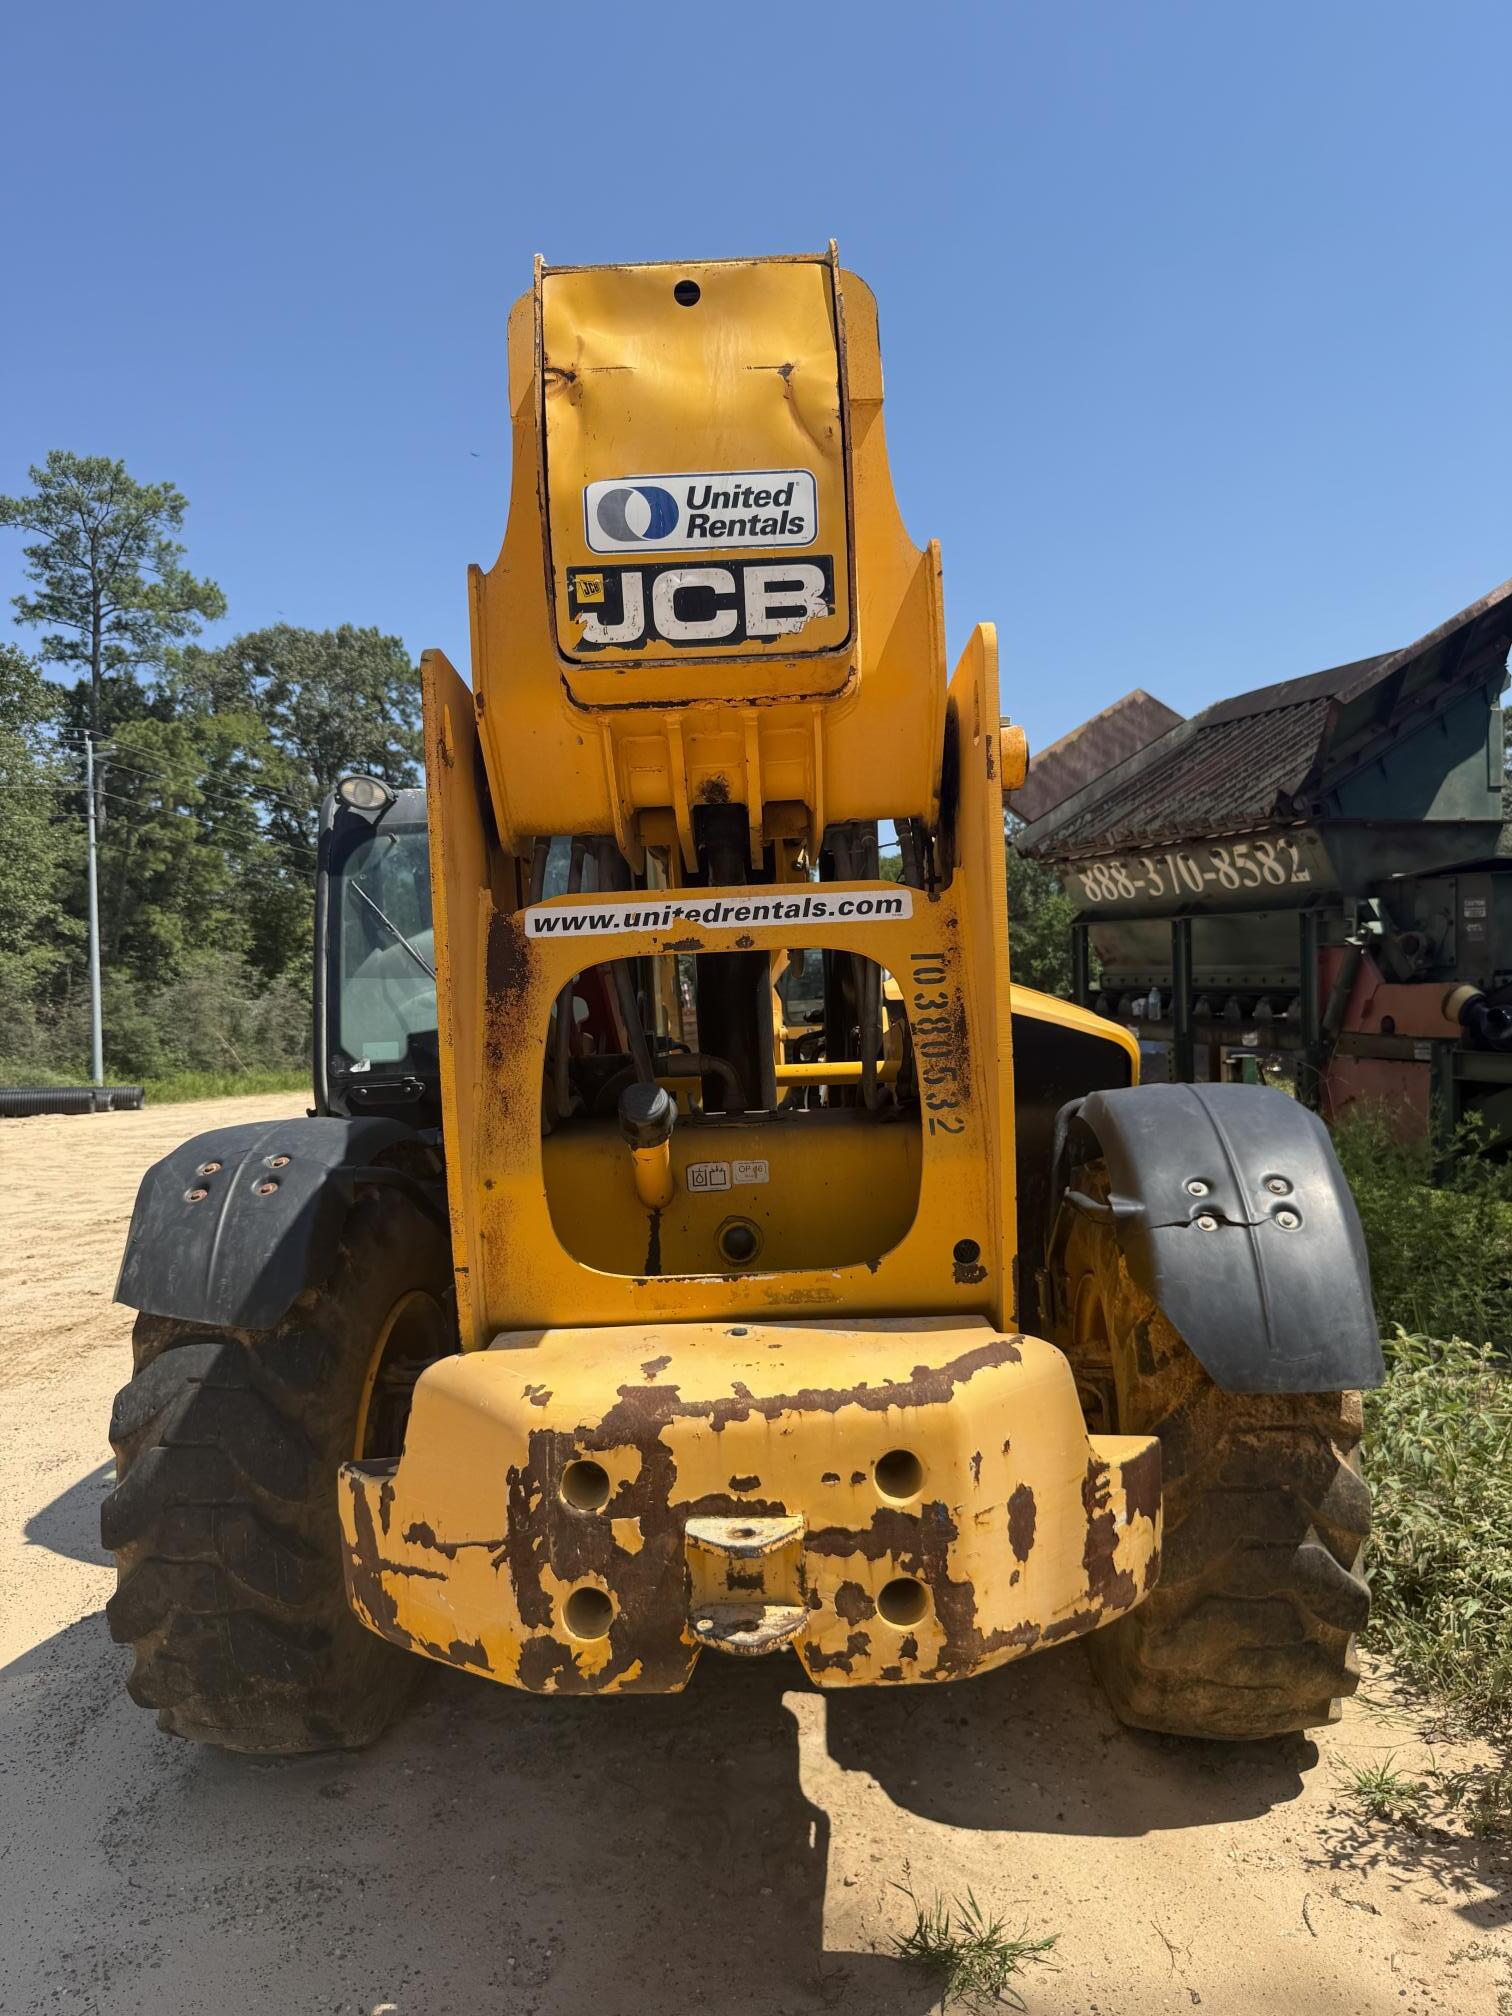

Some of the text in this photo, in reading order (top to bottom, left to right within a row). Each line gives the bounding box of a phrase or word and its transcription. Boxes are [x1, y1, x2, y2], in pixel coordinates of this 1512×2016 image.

[686, 482, 795, 510] United
[686, 510, 805, 538] Rentals
[579, 564, 829, 644] JCB
[583, 580, 602, 596] JCB
[533, 897, 903, 933] www.unitedrentals.com
[910, 953, 966, 1137] 10380532
